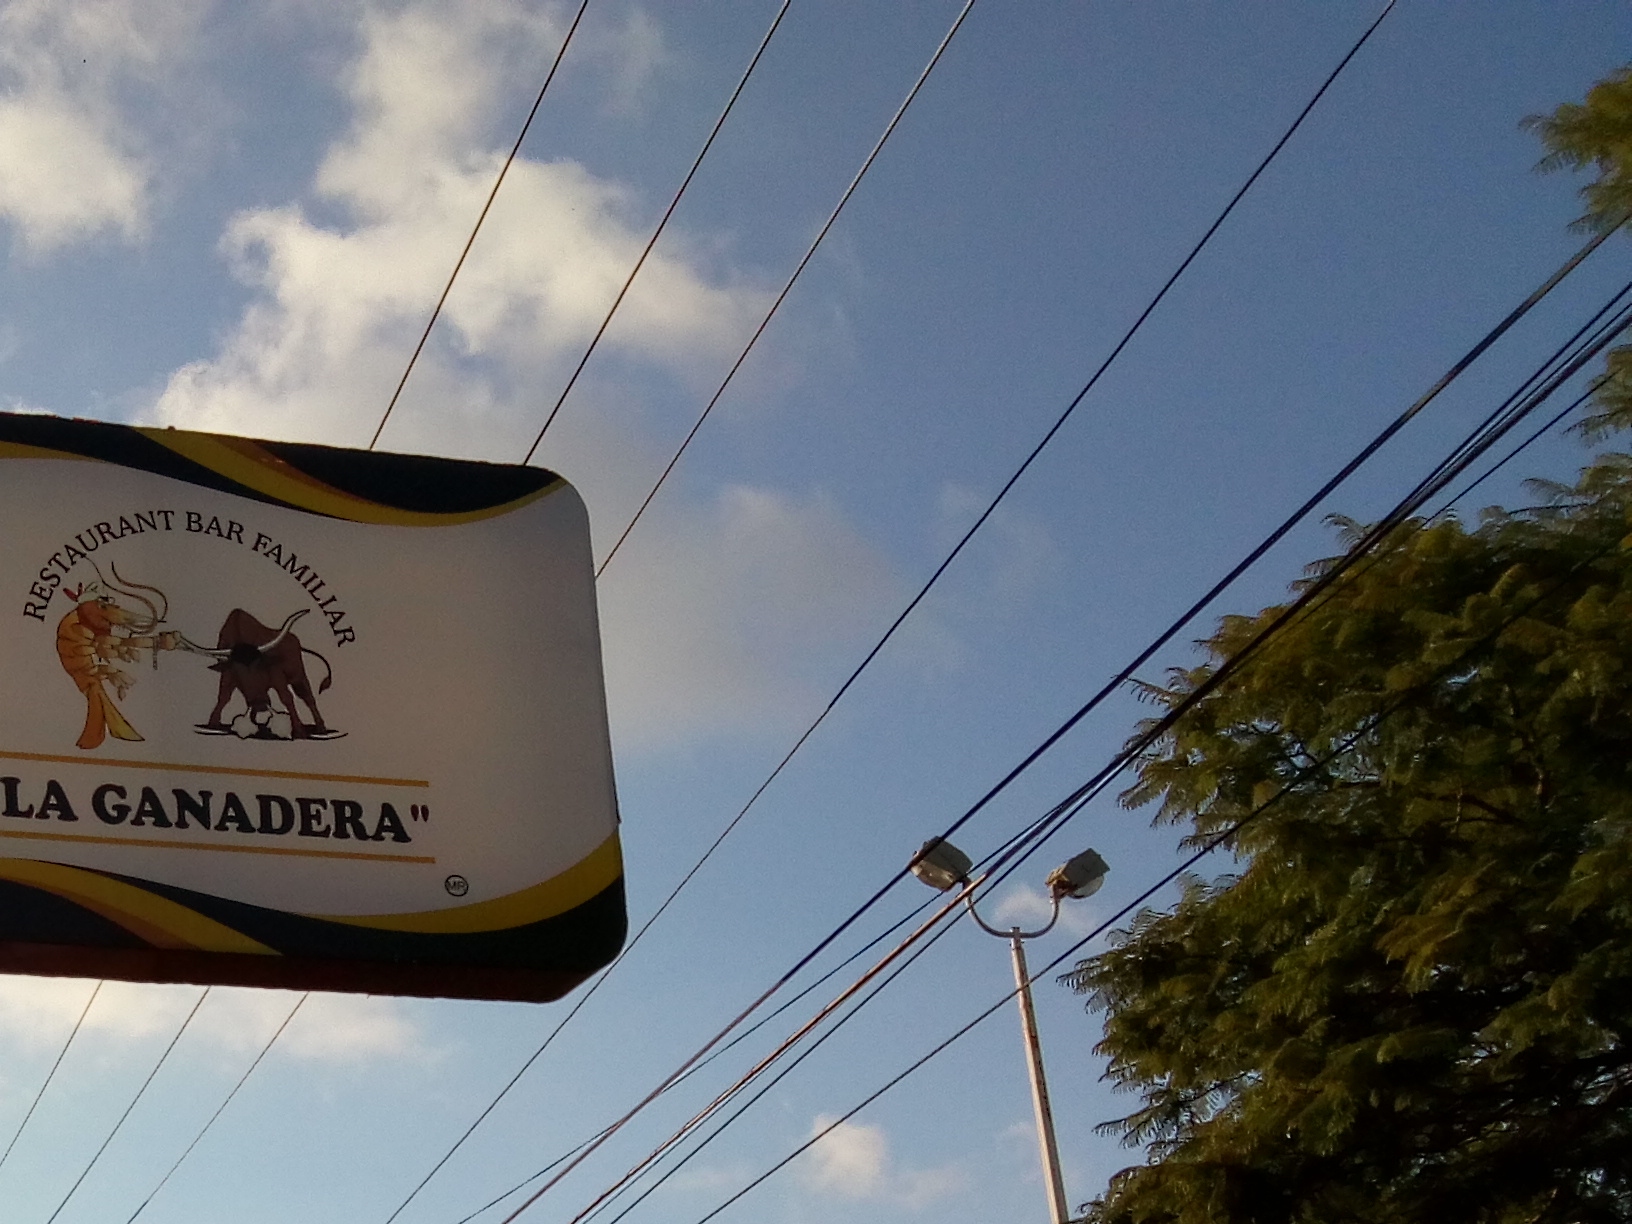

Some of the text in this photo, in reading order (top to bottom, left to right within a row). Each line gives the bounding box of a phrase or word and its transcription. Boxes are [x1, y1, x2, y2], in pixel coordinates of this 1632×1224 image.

[22, 510, 357, 648] RESTAURANT BAR FAMILIAR
